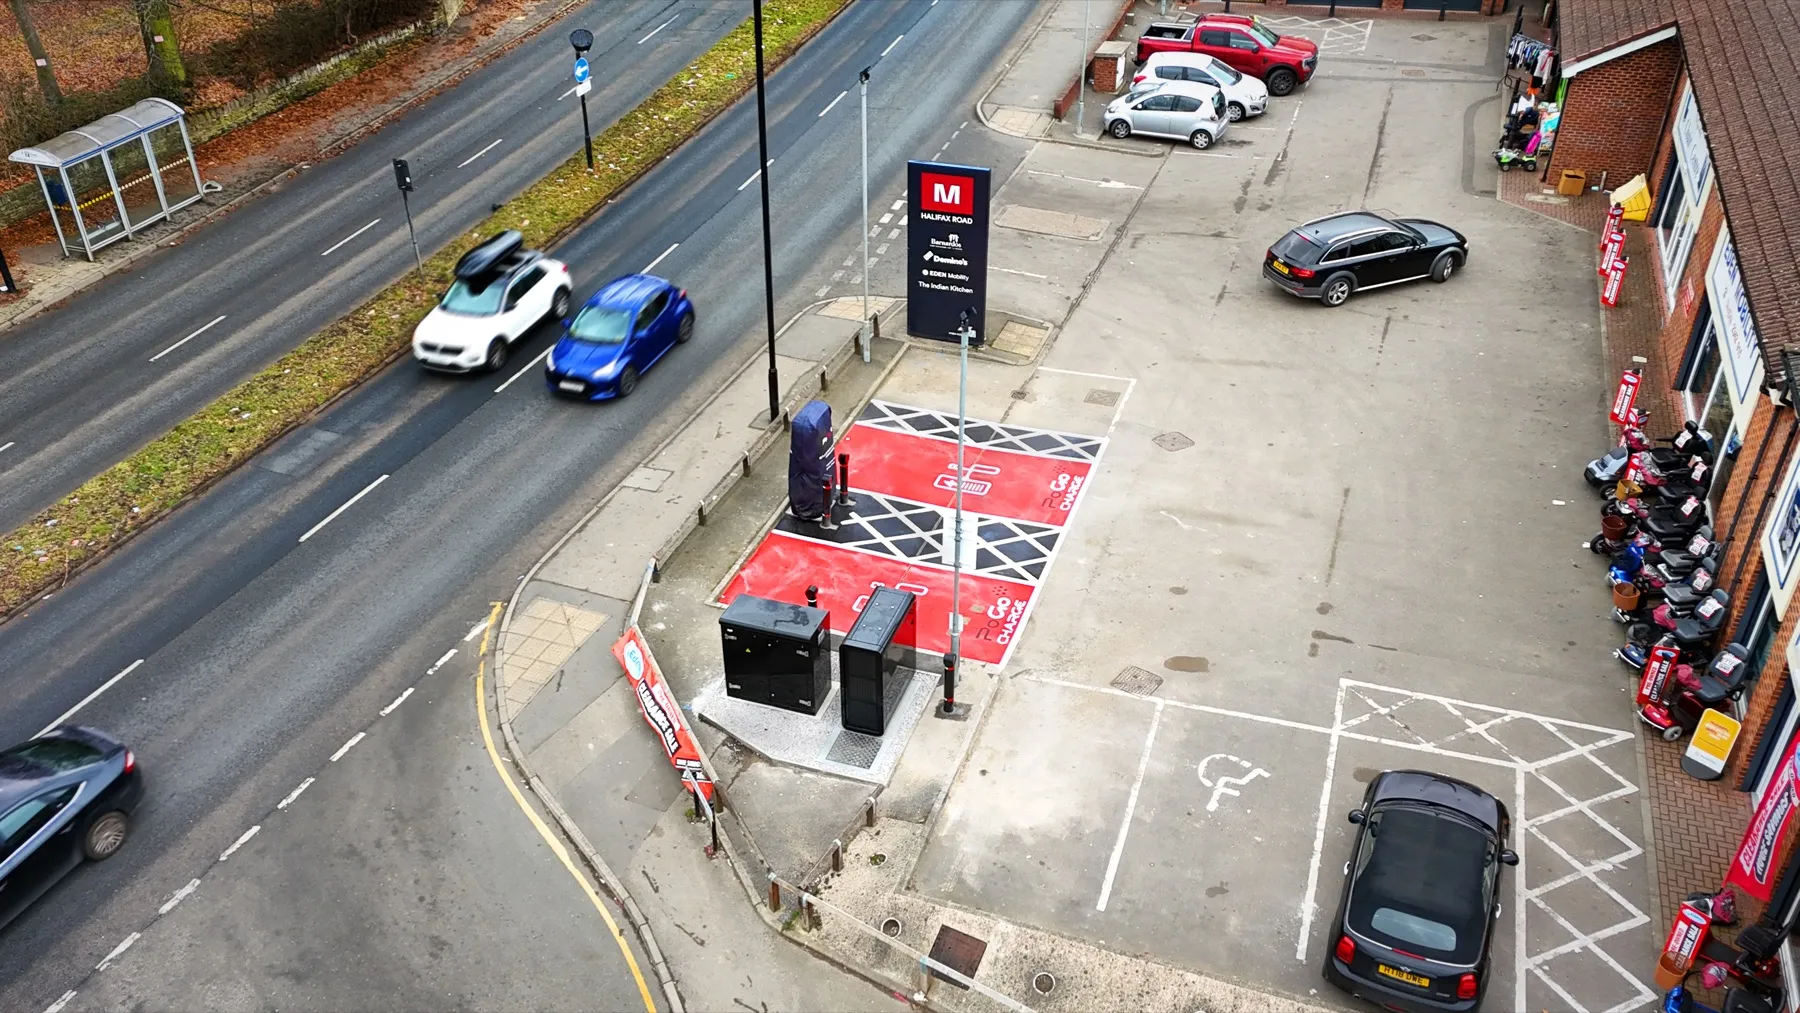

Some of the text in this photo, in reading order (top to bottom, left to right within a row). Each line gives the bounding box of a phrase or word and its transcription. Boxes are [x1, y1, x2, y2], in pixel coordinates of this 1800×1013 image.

[933, 183, 960, 205] M
[920, 212, 973, 225] HALIFAX ROAD
[933, 254, 968, 266] Domino's
[929, 270, 969, 282] EDEN Mobility
[918, 280, 973, 294] The Indian Kitchen
[1059, 475, 1085, 511] CHARGE
[996, 599, 1027, 645] CHARGE
[1659, 659, 1670, 673] SALE
[638, 681, 679, 753] CLEARANCE SALE
[1686, 923, 1699, 940] SALE
